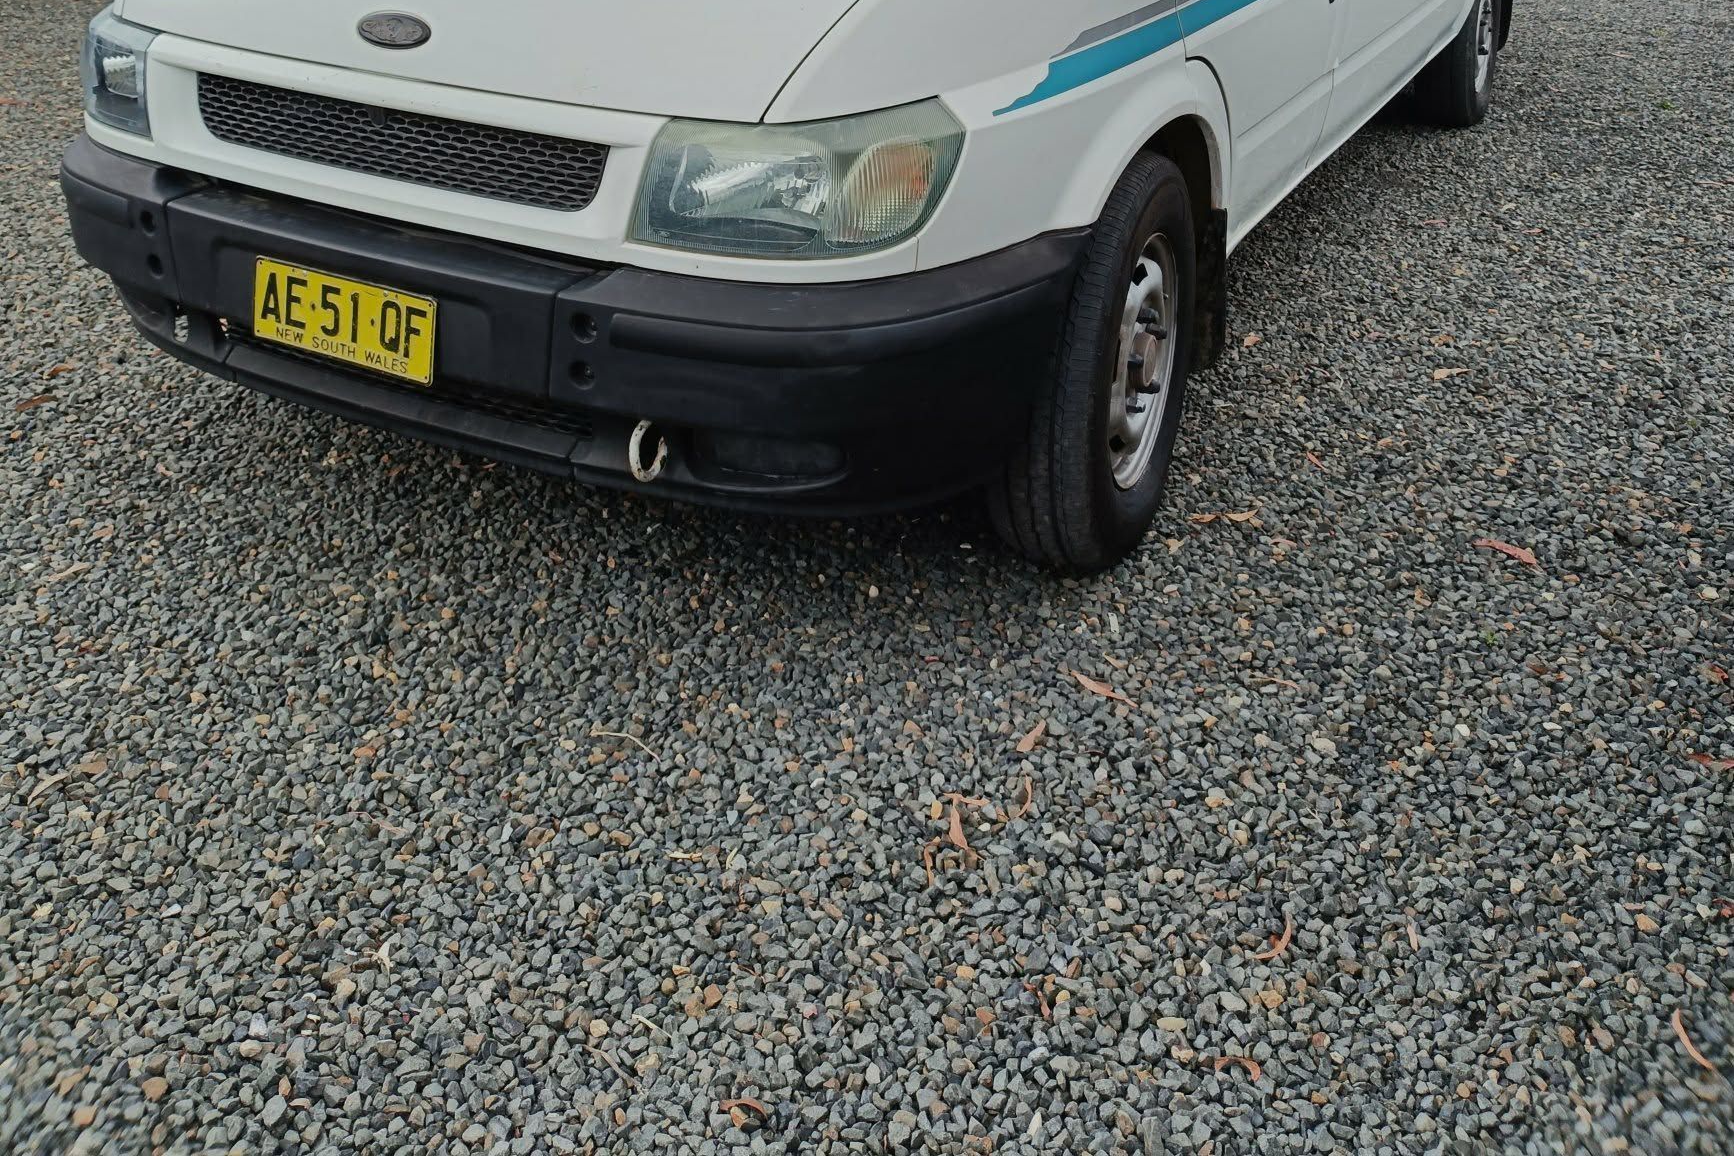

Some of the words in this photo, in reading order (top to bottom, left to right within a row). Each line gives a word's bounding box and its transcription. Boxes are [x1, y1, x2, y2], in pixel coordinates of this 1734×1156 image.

[275, 326, 304, 344] NEW
[312, 336, 356, 359] SOUTH
[364, 349, 409, 374] WALES
